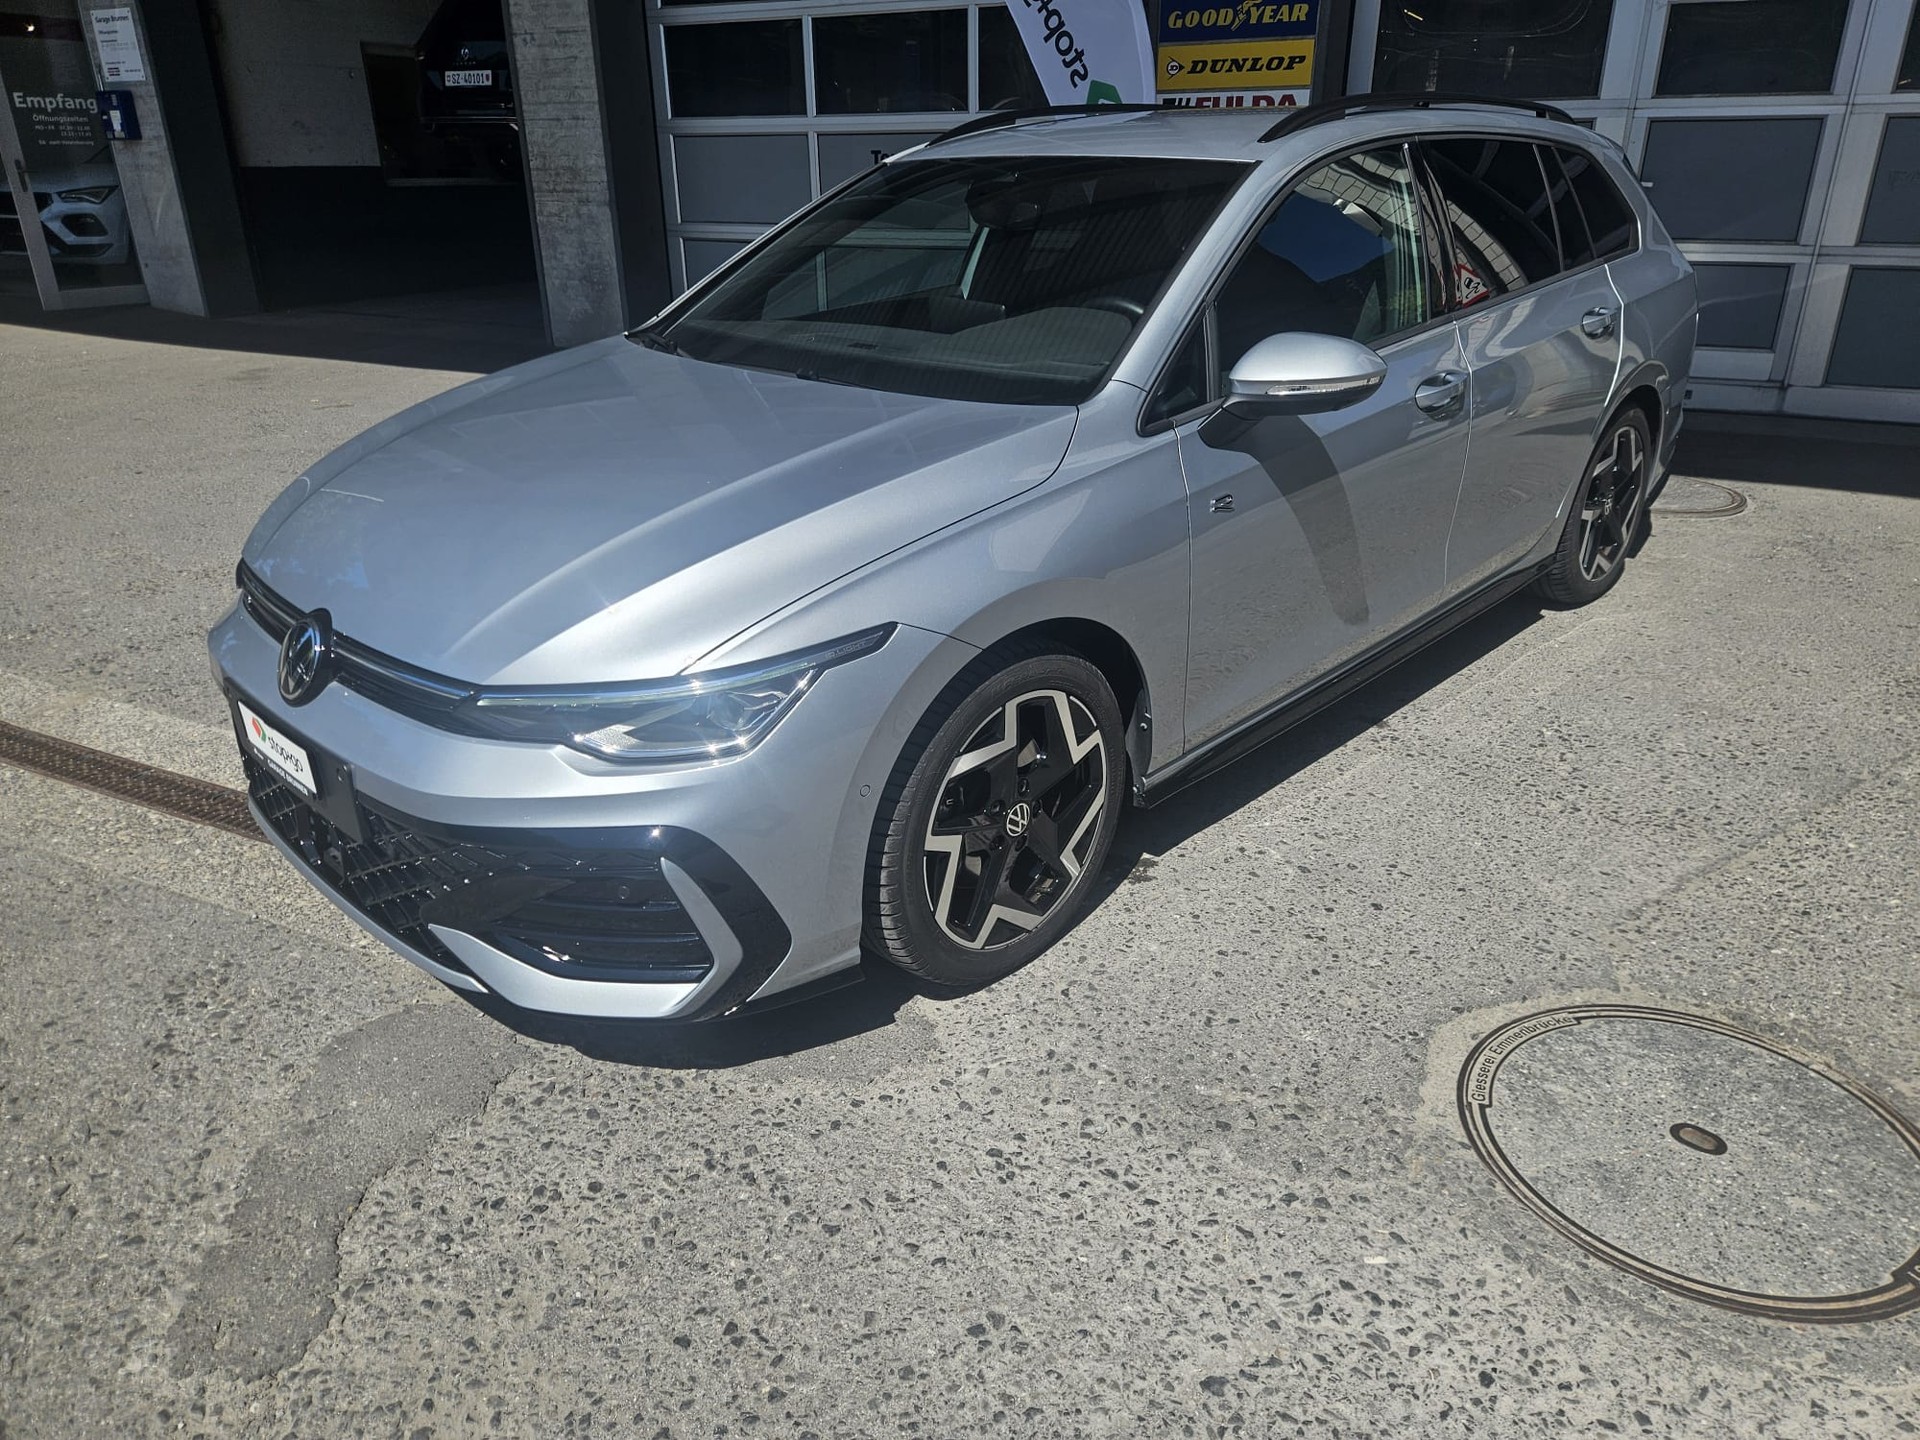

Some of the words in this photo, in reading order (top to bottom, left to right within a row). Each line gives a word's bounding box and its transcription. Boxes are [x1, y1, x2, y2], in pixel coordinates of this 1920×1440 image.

[1187, 55, 1306, 74] DUNLOP
[13, 92, 98, 113] Empfang
[1471, 1053, 1498, 1102] Giesserei
